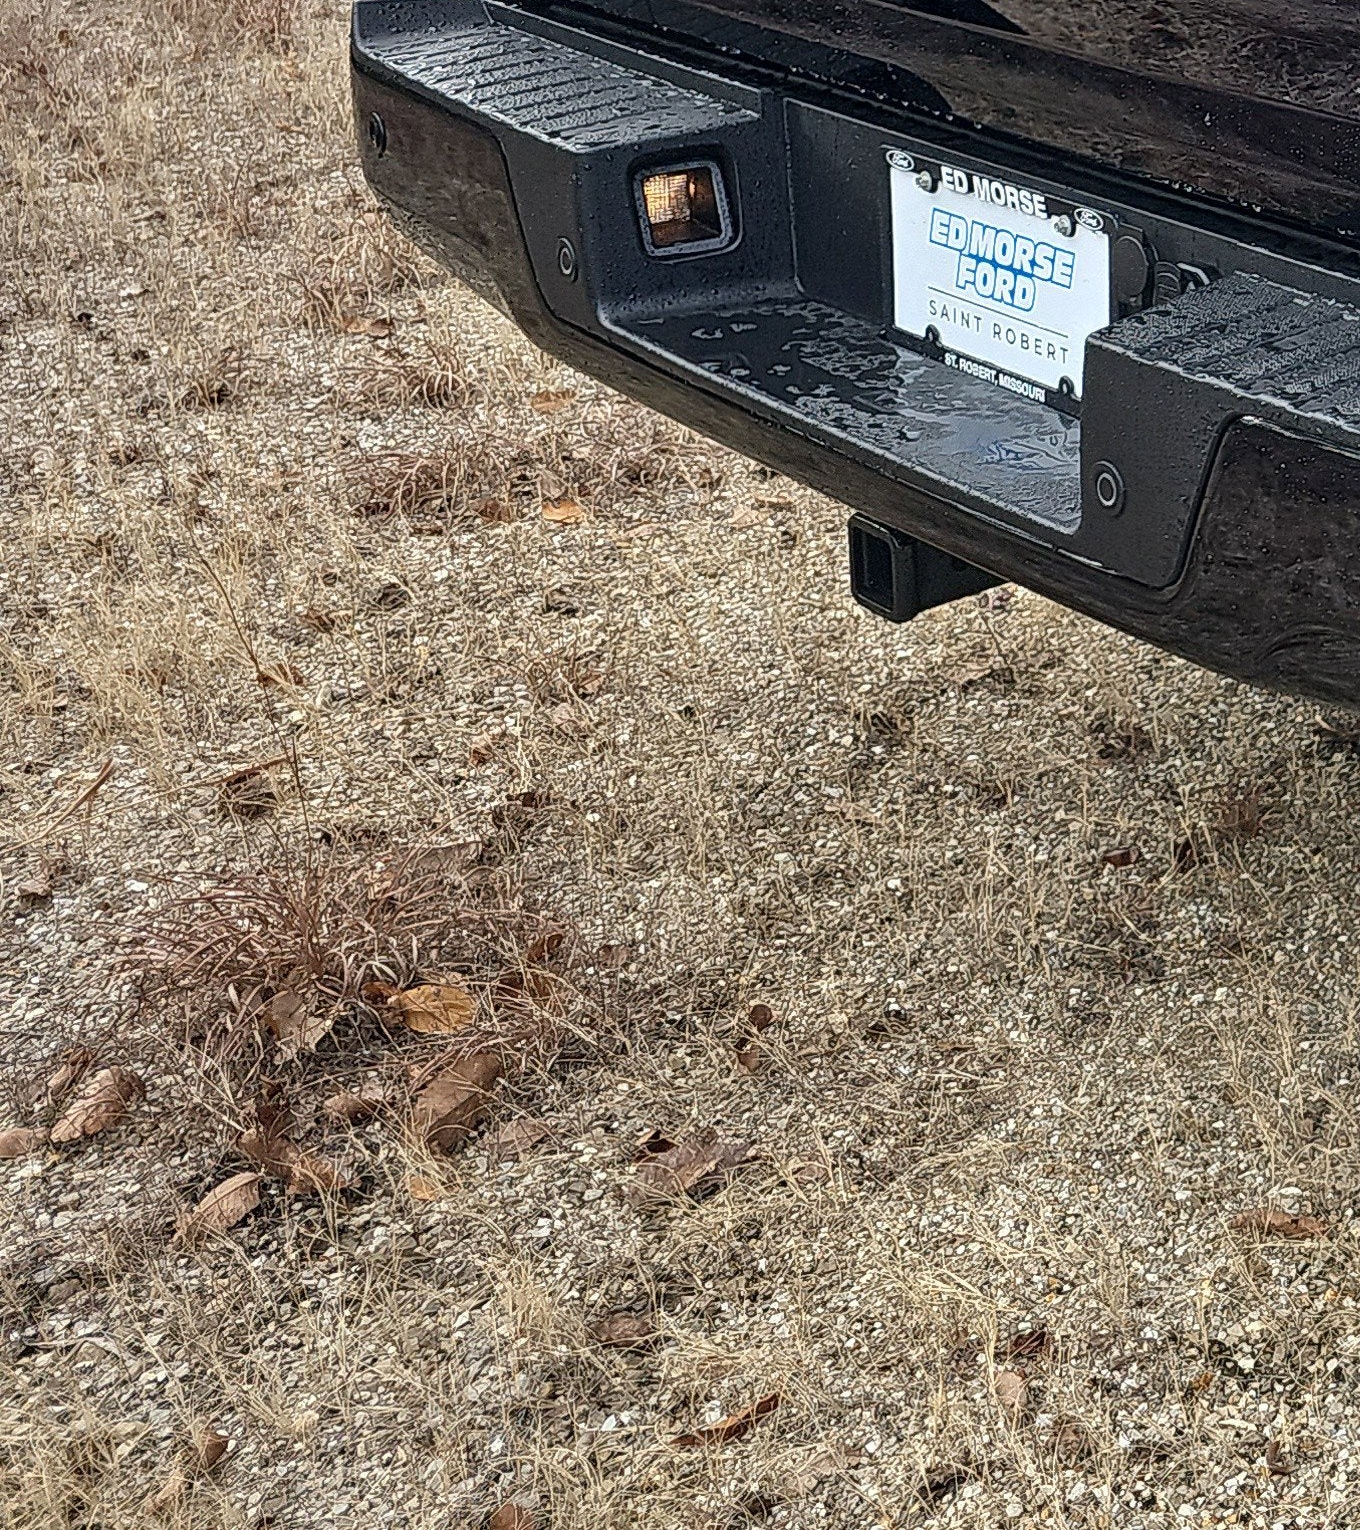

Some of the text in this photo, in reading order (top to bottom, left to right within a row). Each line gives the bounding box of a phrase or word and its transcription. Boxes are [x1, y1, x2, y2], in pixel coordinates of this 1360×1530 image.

[940, 165, 1049, 220] ED MORSE
[929, 207, 1075, 289] ED MORSE
[956, 251, 1037, 312] FORD
[928, 299, 1070, 365] SAINT ROBERT
